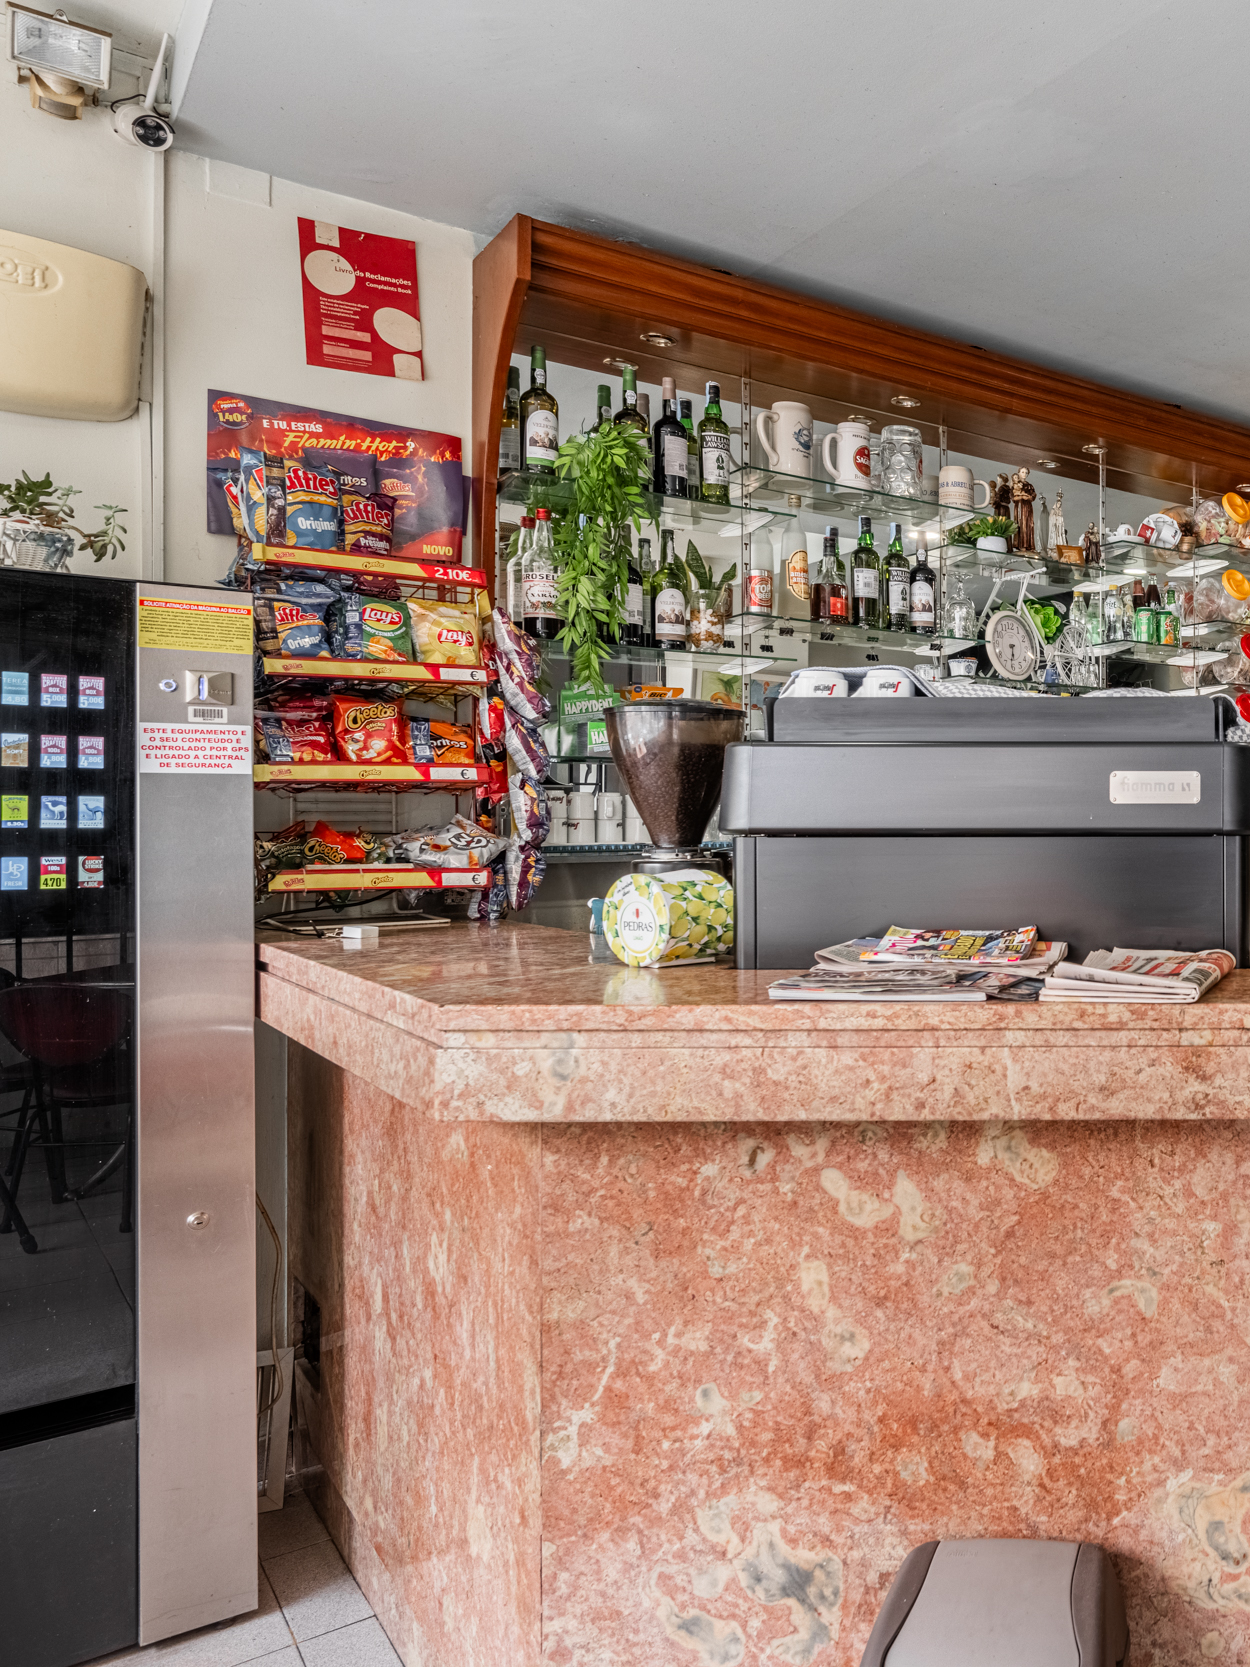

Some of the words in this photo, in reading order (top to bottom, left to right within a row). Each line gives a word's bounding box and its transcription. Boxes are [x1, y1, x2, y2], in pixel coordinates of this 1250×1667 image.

[334, 266, 354, 275] Livro
[365, 271, 412, 286] Reclamações
[365, 281, 397, 293] Complaints
[262, 419, 271, 428] E
[291, 421, 323, 433] ESTÁS
[359, 437, 404, 451] Hot
[285, 466, 340, 499] uffles
[339, 474, 368, 487] ritos
[380, 478, 412, 494] Ruffles
[343, 500, 393, 530] uffles
[297, 516, 338, 533] Original
[423, 544, 453, 556] NOVO
[434, 566, 472, 582] 2,10€
[755, 584, 771, 593] TOP
[166, 602, 190, 610] ATIVAÇÃO
[198, 604, 220, 612] MÁQUINA
[363, 607, 401, 624] Lay's
[1000, 623, 1007, 632] 11
[1007, 622, 1015, 631] 12
[287, 633, 322, 650] Original
[440, 628, 473, 647] Lay's
[469, 670, 480, 681] €
[42, 679, 66, 689] CRAFTED
[79, 681, 103, 691] CRAFTED
[564, 697, 613, 715] HAPPYDENT
[347, 703, 397, 729] Cheetos
[171, 728, 238, 736] EQUIPAMENTO
[42, 740, 65, 749] CRAFTED
[79, 741, 103, 750] CRAFTED
[181, 736, 233, 744] CONTEÚDO
[141, 744, 207, 752] CONTROLADO
[175, 762, 233, 770] SEGURANÇA
[460, 768, 471, 780] €
[1120, 776, 1175, 792] fiamma
[304, 838, 347, 864] Cheetos
[471, 873, 482, 885] €
[623, 920, 654, 932] PEDRAS
